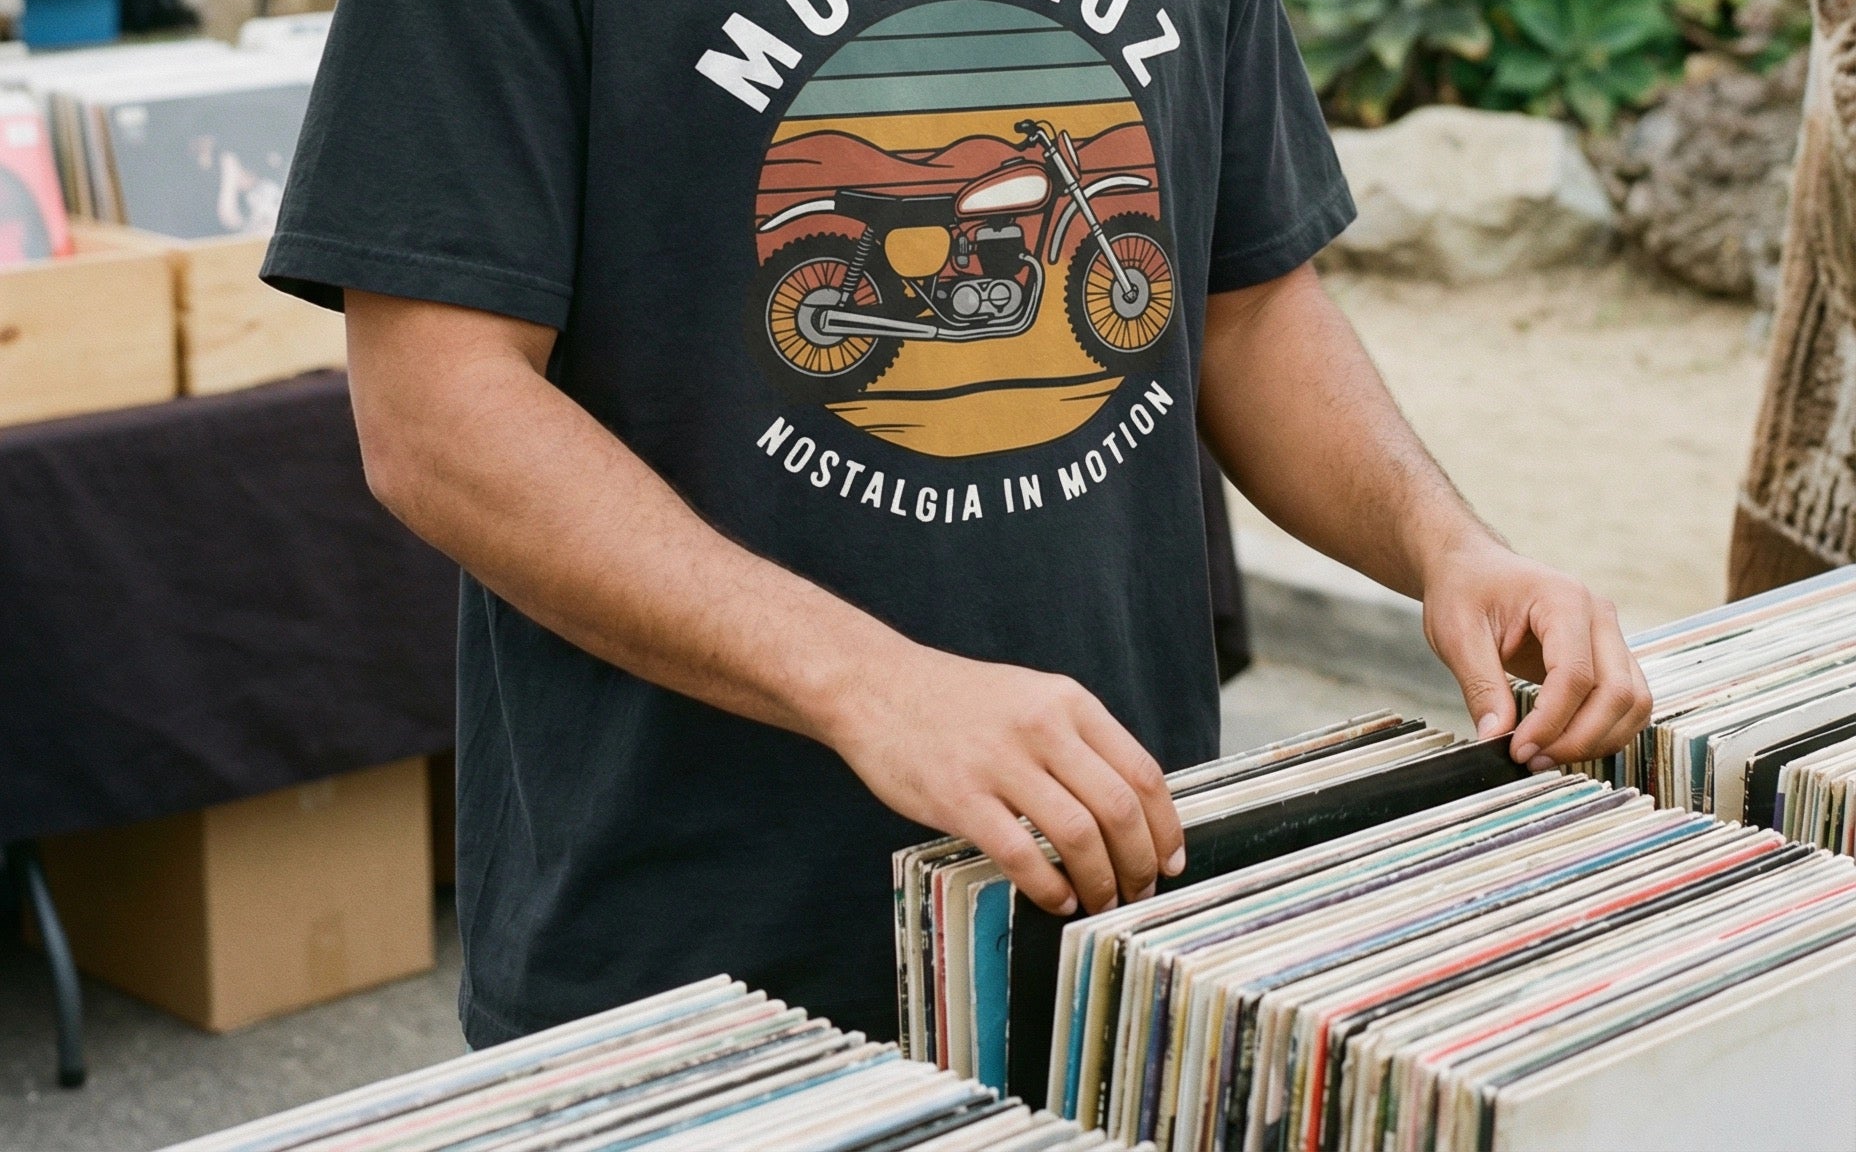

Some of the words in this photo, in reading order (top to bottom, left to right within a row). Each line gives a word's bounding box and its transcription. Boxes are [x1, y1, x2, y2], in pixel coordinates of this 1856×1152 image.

[756, 416, 983, 524] NOSTALGIA
[1003, 474, 1043, 514] IN
[1057, 380, 1174, 501] MOTION
